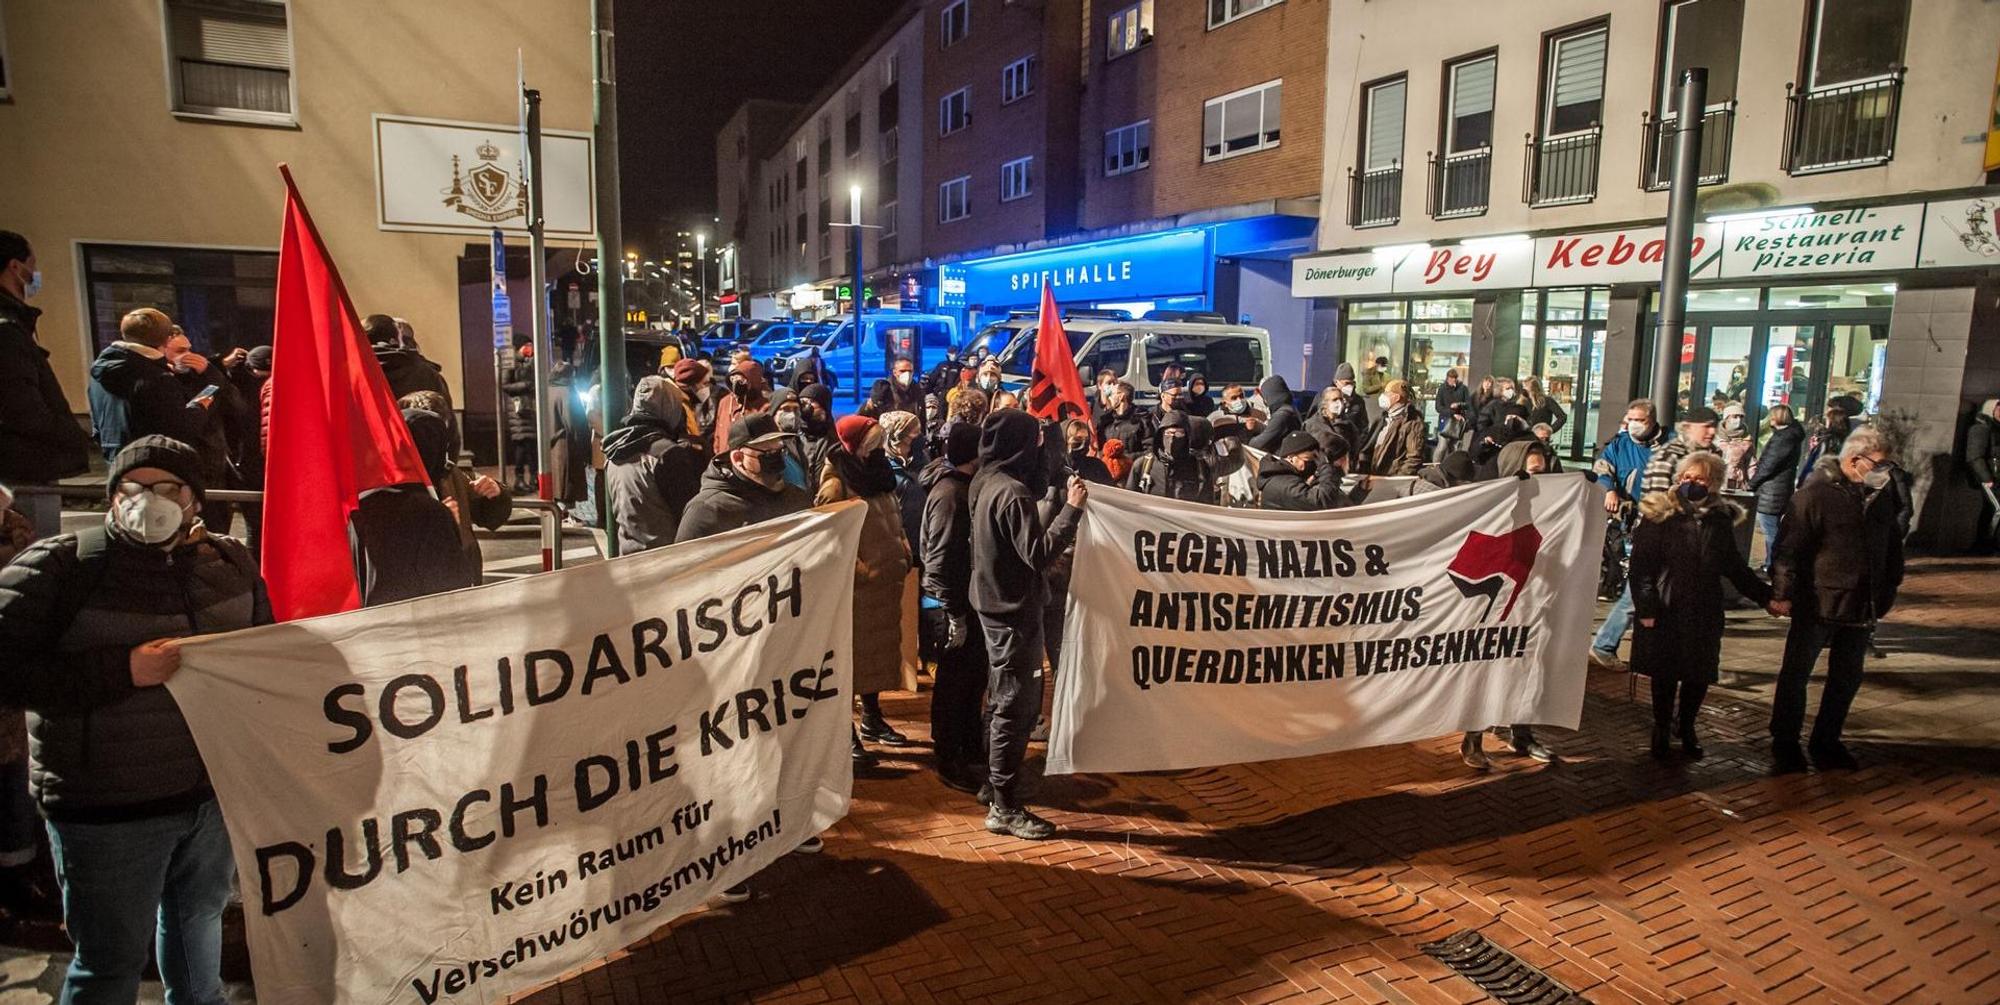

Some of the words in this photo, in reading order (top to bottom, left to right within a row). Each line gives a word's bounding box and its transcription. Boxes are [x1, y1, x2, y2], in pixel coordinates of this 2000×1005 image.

[1735, 224, 1905, 252] Restaurant
[1760, 207, 1878, 231] Schnell-
[1305, 265, 1378, 281] Dönerburger
[1424, 249, 1496, 284] Bey
[1752, 249, 1875, 272] Pizzeria
[1134, 530, 1248, 577] GEGEN
[1255, 538, 1358, 578] NAZIS
[1364, 544, 1390, 577] &
[1130, 586, 1423, 632] ANTISEMITISMUS
[323, 566, 803, 755] SOLIDARISCH
[1131, 642, 1345, 690] QUERDENKEN
[1354, 625, 1529, 677] VERSENKEN!
[255, 774, 550, 917] DURCH
[574, 725, 679, 814] DIE
[699, 651, 839, 757] KRISE
[489, 868, 568, 916] Kein
[578, 825, 665, 881] Raum
[670, 798, 716, 850] für
[411, 809, 783, 1005] Verschwörungsmythen!
